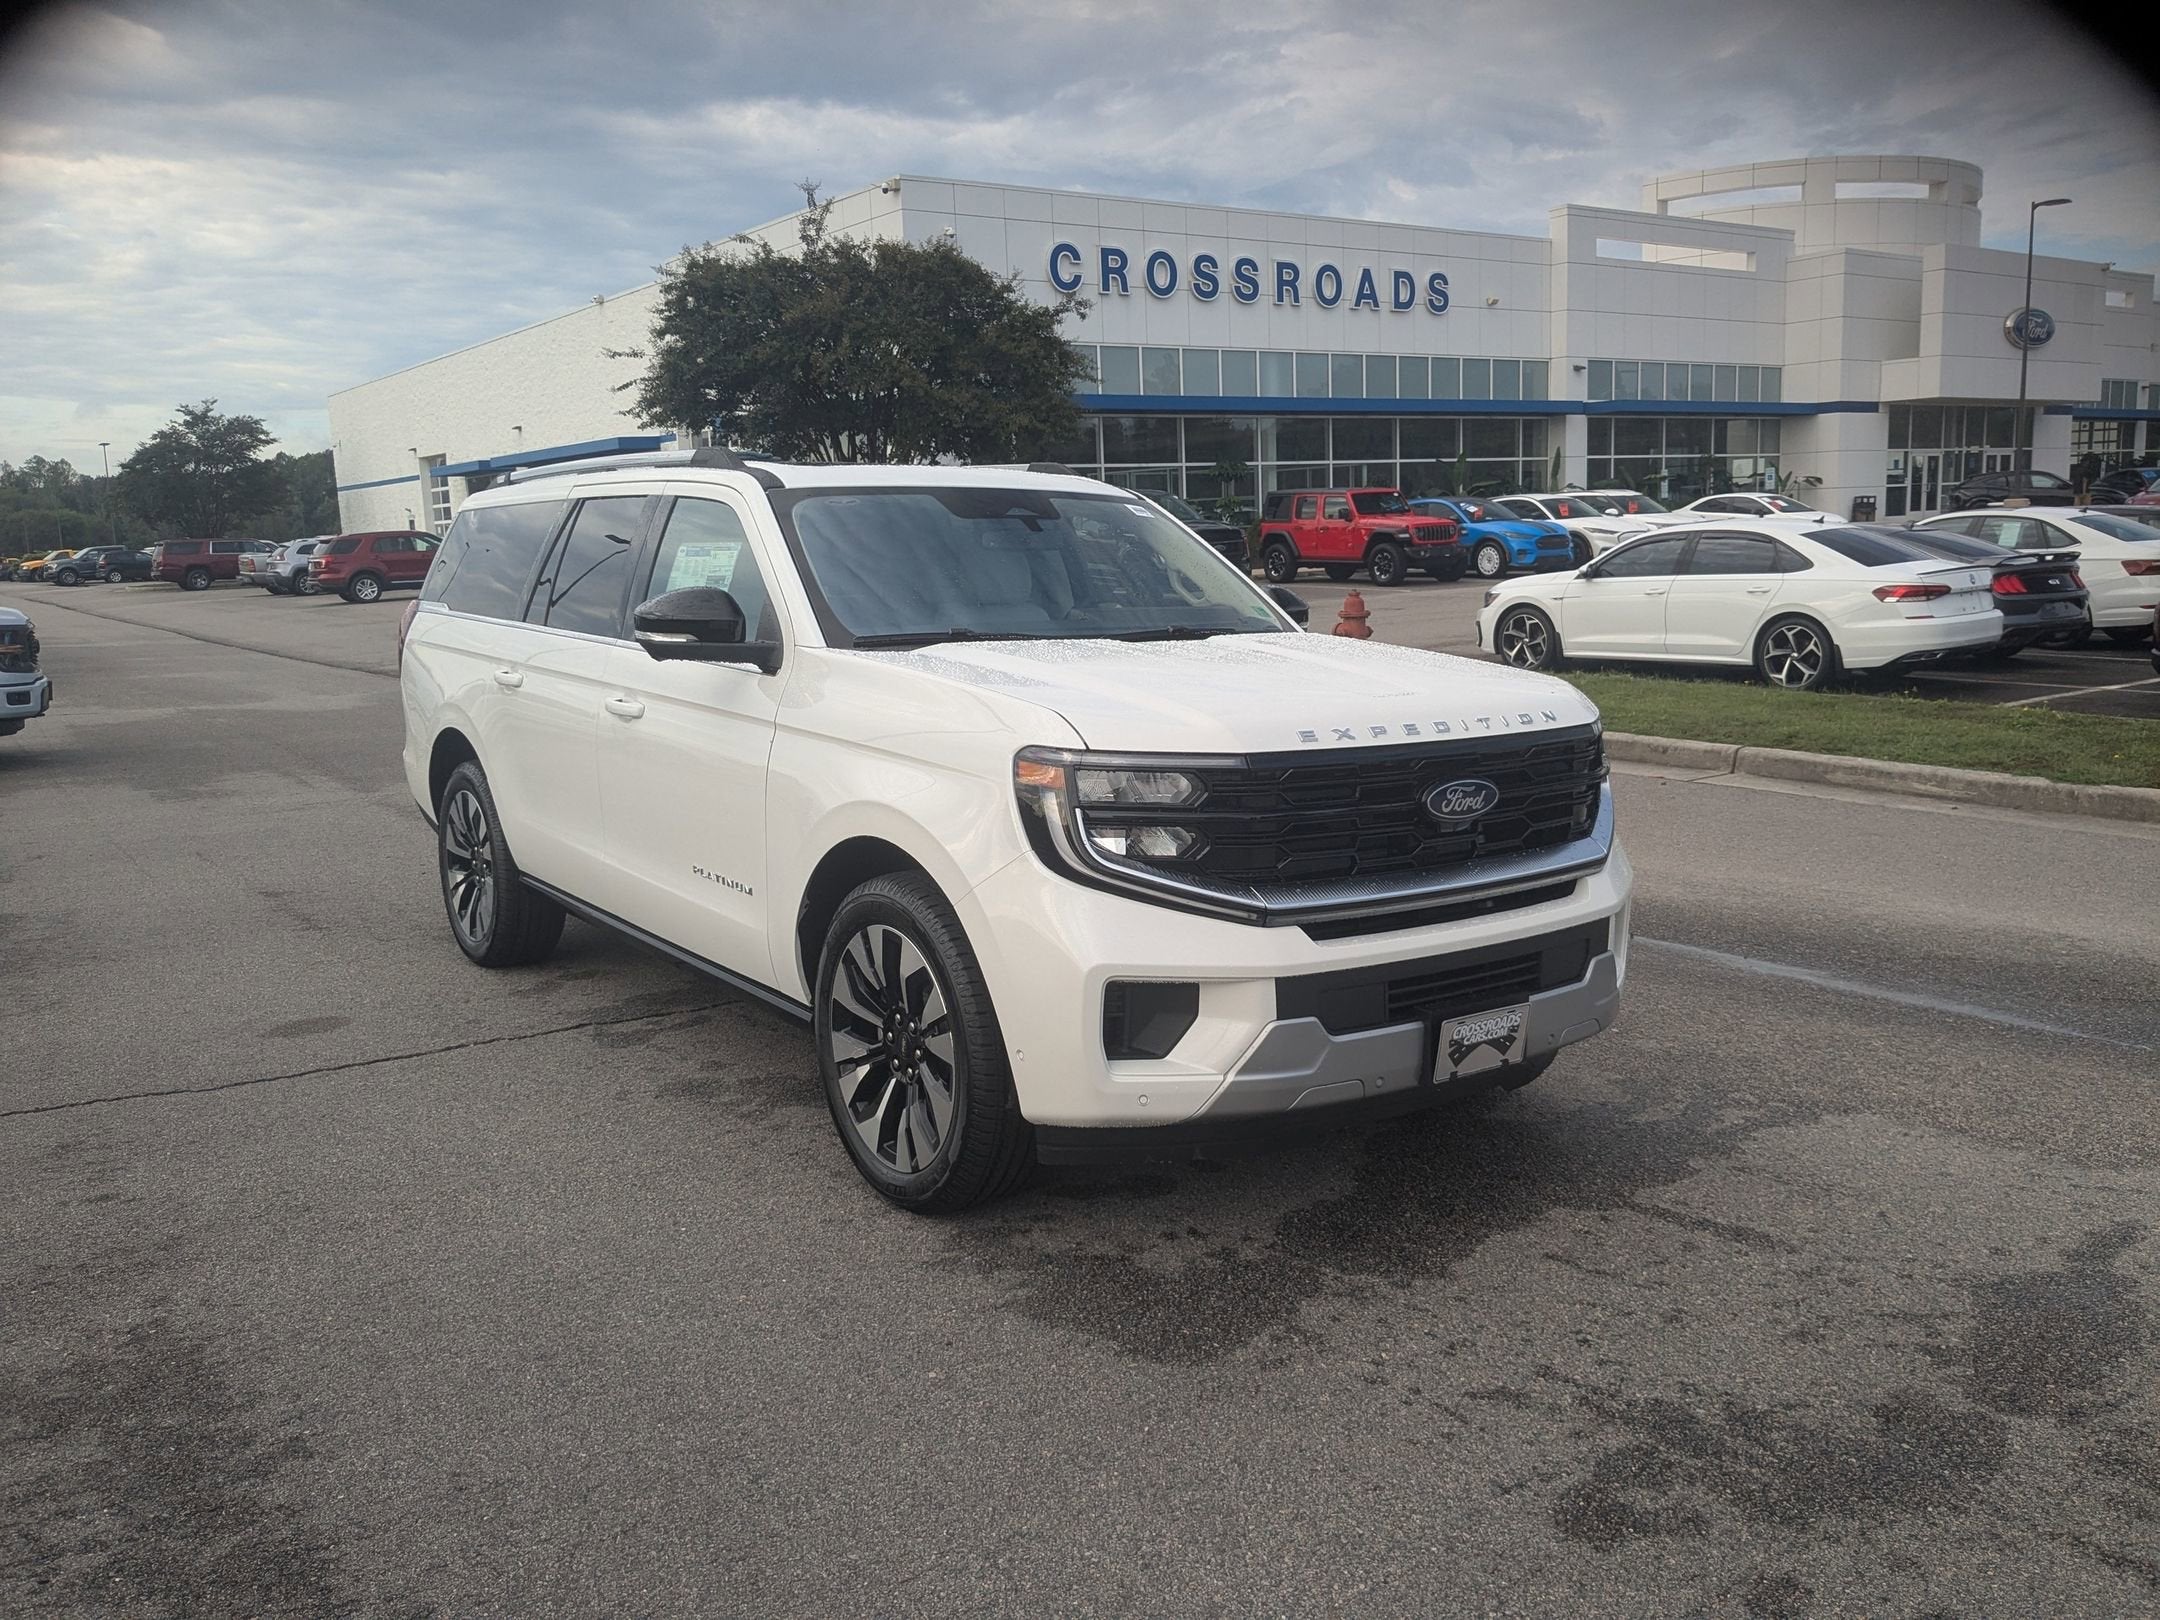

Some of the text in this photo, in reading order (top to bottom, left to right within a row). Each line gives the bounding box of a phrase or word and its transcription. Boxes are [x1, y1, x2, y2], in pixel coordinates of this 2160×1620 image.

[1048, 241, 1451, 315] CROSSROADS
[1296, 710, 1558, 743] EXPEDITION
[1441, 785, 1486, 813] Ford
[692, 865, 753, 896] PLATINUM
[1452, 1012, 1522, 1040] CROSSROADS
[1462, 1027, 1508, 1045] CARS.COM
